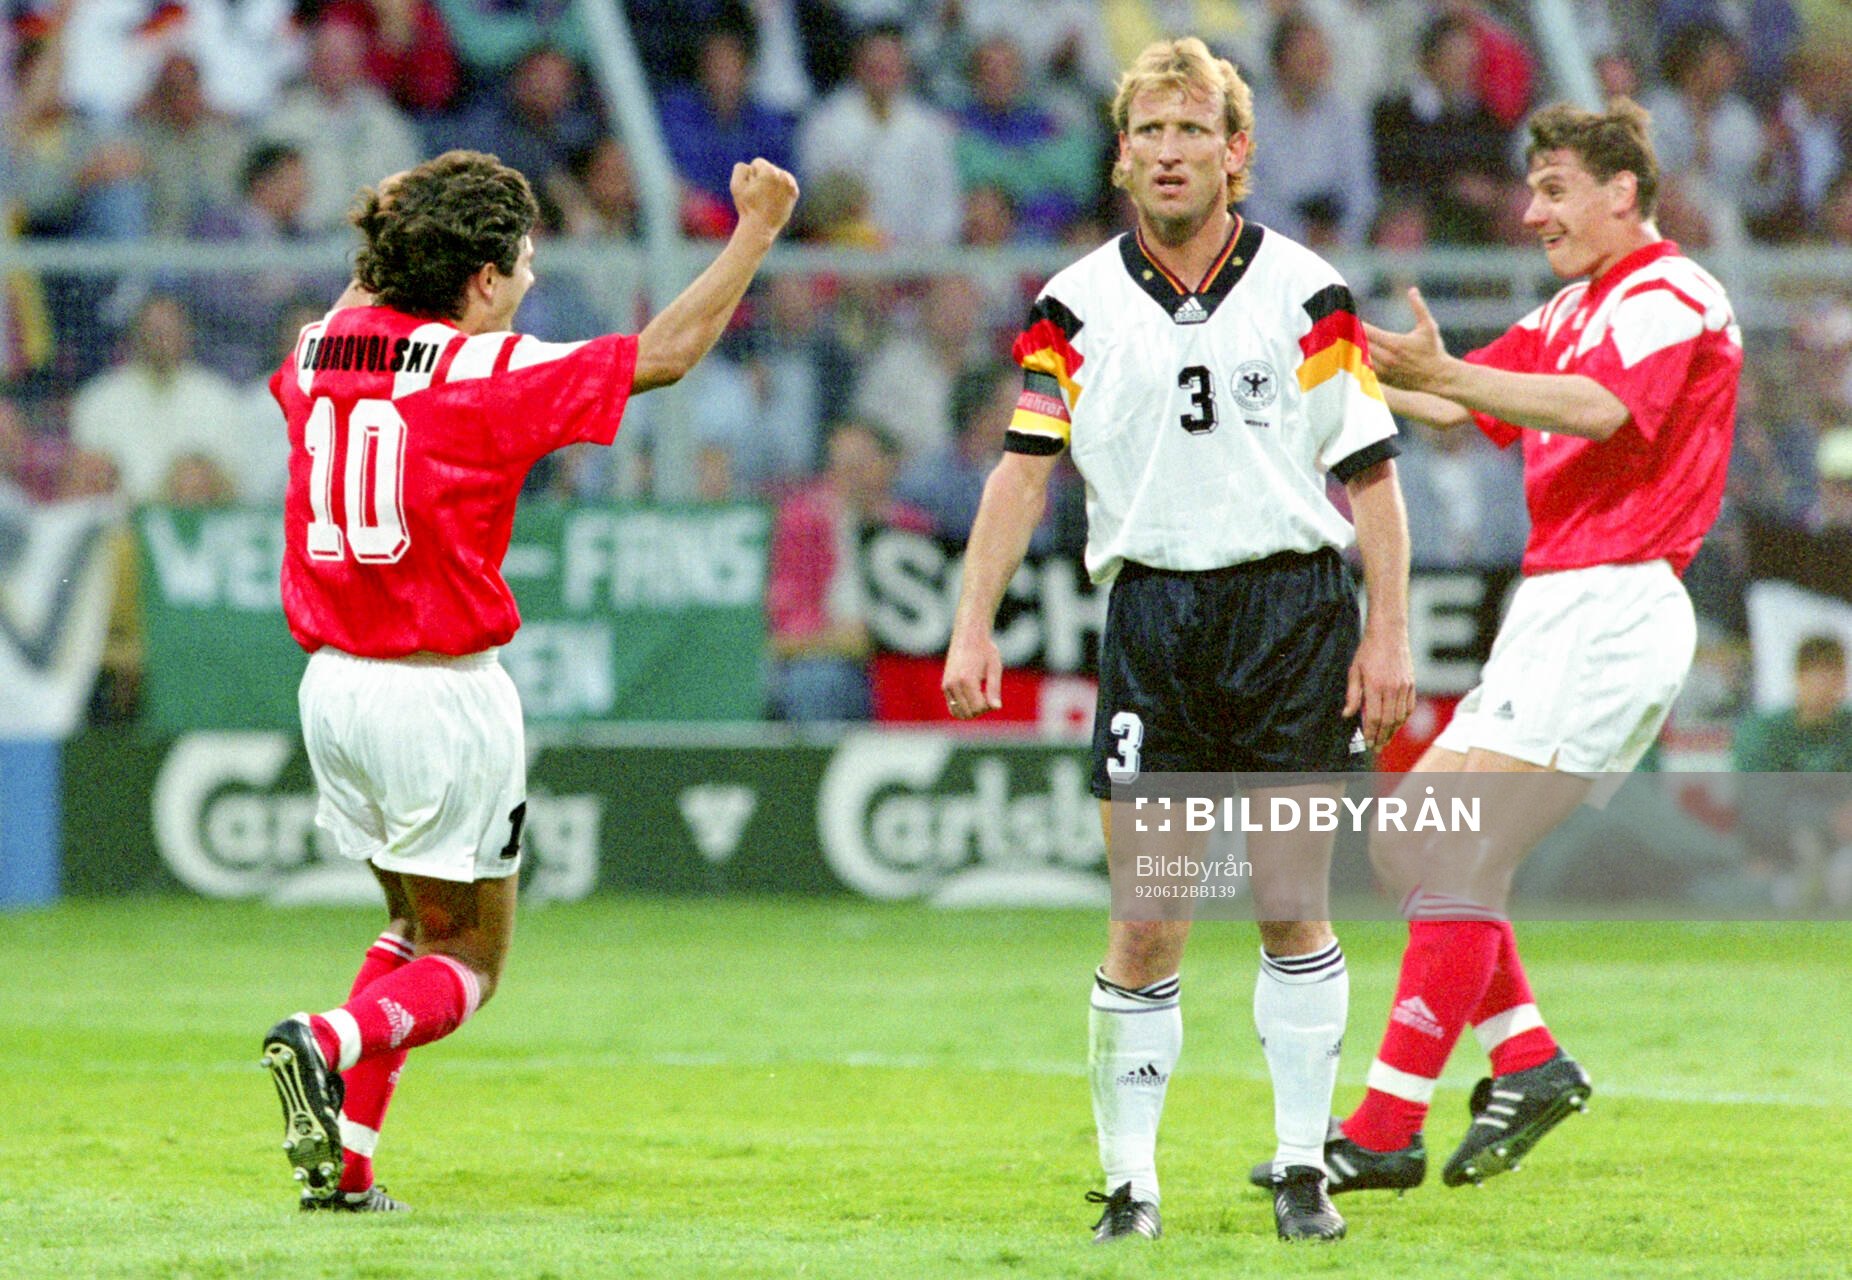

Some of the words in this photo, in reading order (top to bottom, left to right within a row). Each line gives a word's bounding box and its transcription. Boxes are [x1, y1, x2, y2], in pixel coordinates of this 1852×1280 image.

[302, 335, 439, 374] DOBROVOLSKI
[1178, 365, 1218, 435] 3
[304, 397, 411, 564] 10
[1107, 712, 1144, 785] 3
